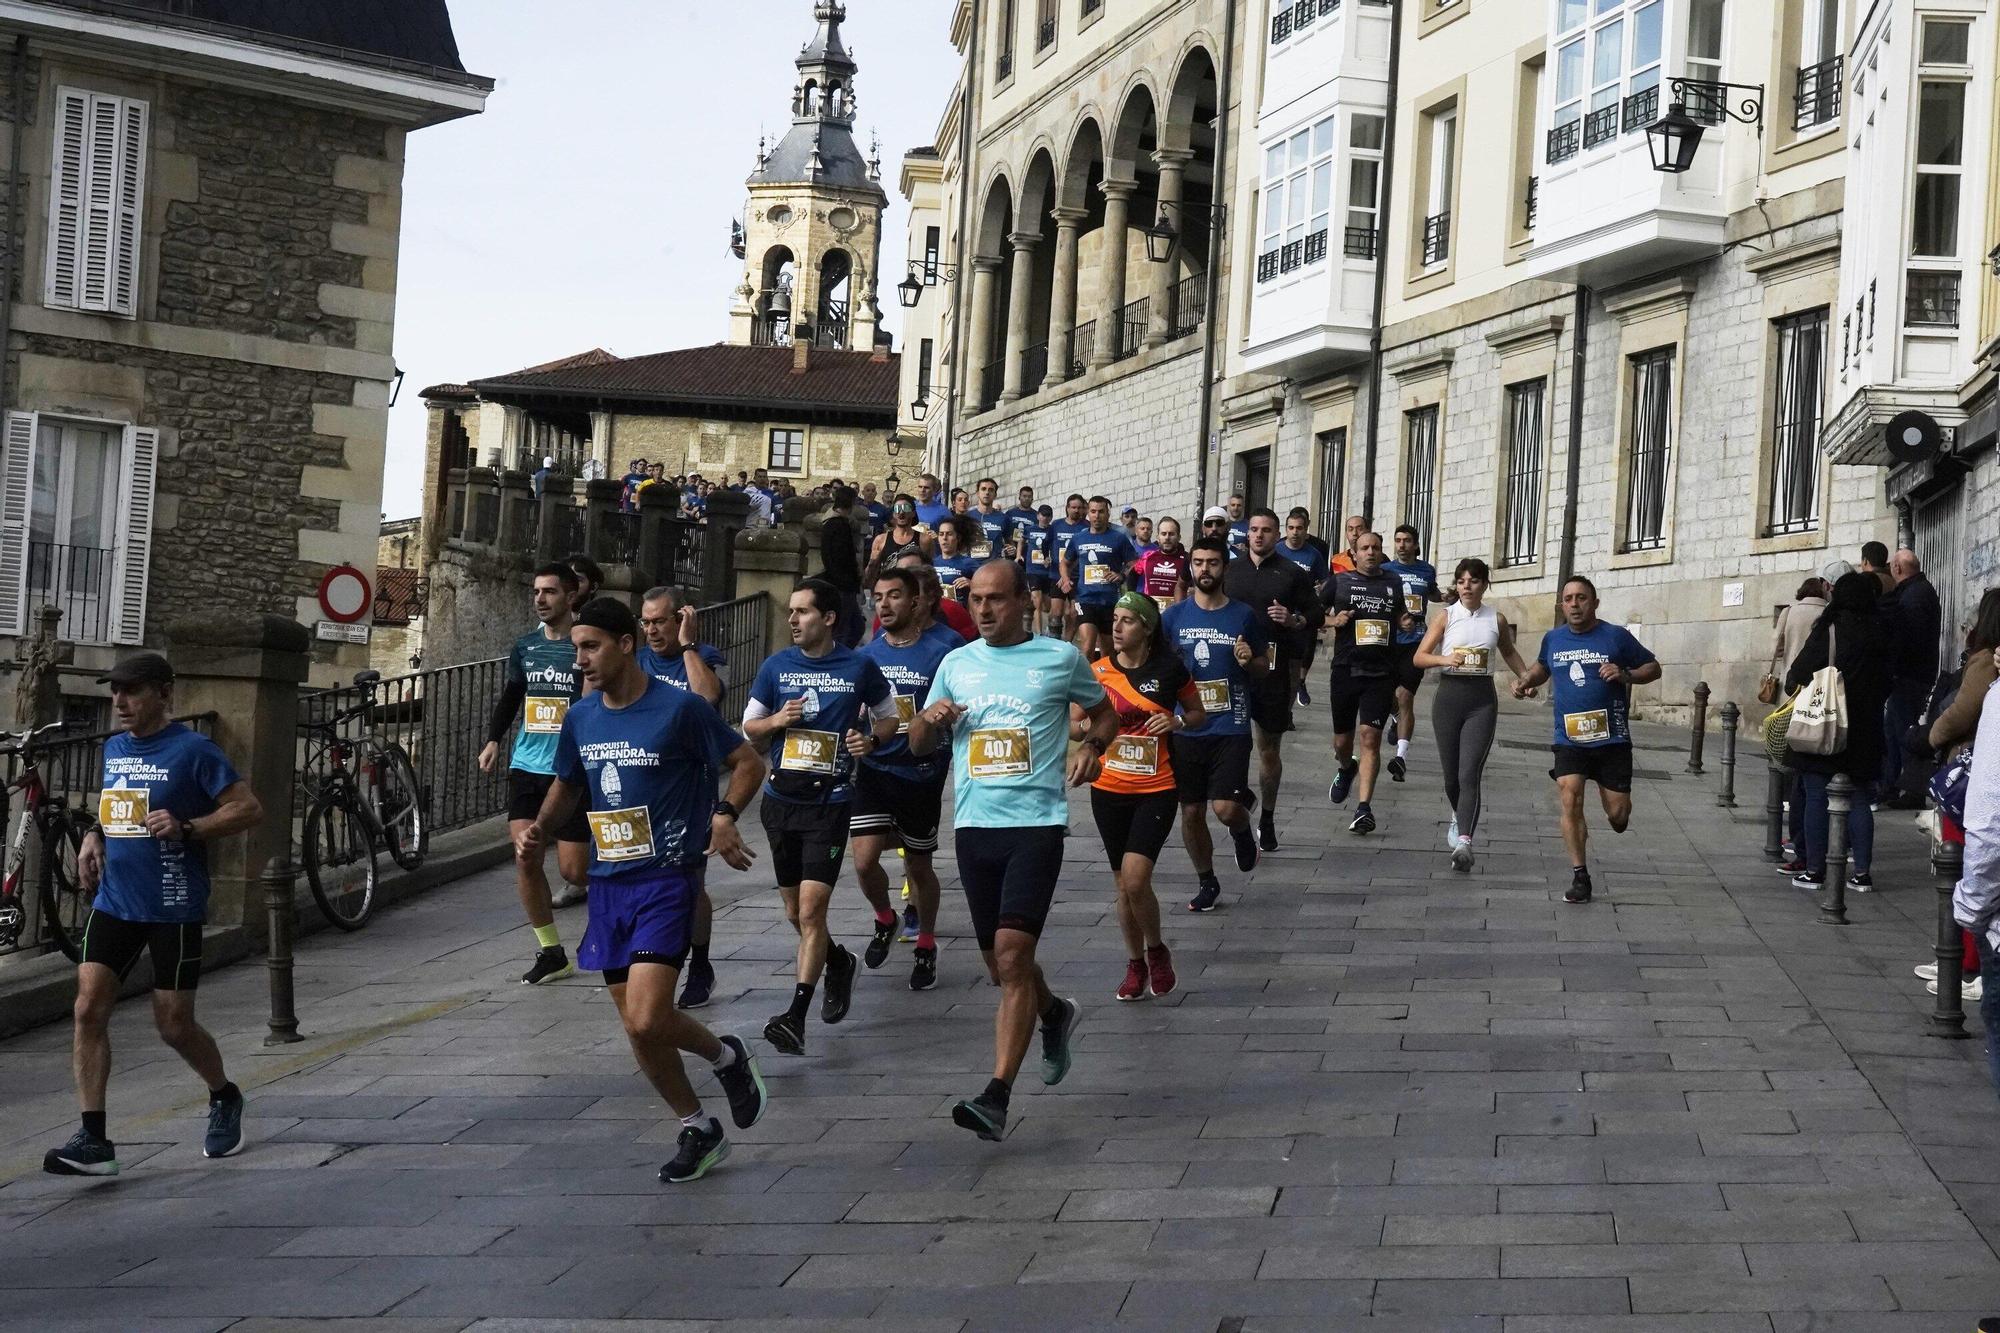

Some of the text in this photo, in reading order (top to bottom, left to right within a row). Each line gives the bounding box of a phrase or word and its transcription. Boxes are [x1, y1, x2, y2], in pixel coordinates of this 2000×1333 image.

[1364, 625, 1382, 636] 295
[1559, 652, 1601, 662] ALMENDRA
[788, 672, 831, 680] CONQUISTA
[789, 678, 846, 687] ALMENDRA
[896, 678, 929, 687] KONKISTA
[966, 693, 1032, 715] TLETICO
[535, 705, 557, 720] 607
[1577, 719, 1598, 732] 436
[586, 741, 630, 752] CONQUISTA
[797, 739, 822, 757] 162
[983, 739, 1012, 759] 407
[1117, 744, 1144, 760] 450
[588, 747, 647, 762] ALMENDRA
[111, 757, 143, 765] CONQUISTA
[617, 758, 660, 767] KONKISTA
[109, 764, 157, 774] ALMENDRA
[128, 773, 169, 782] KONKISTA
[110, 800, 134, 820] 397
[600, 821, 634, 844] 589
